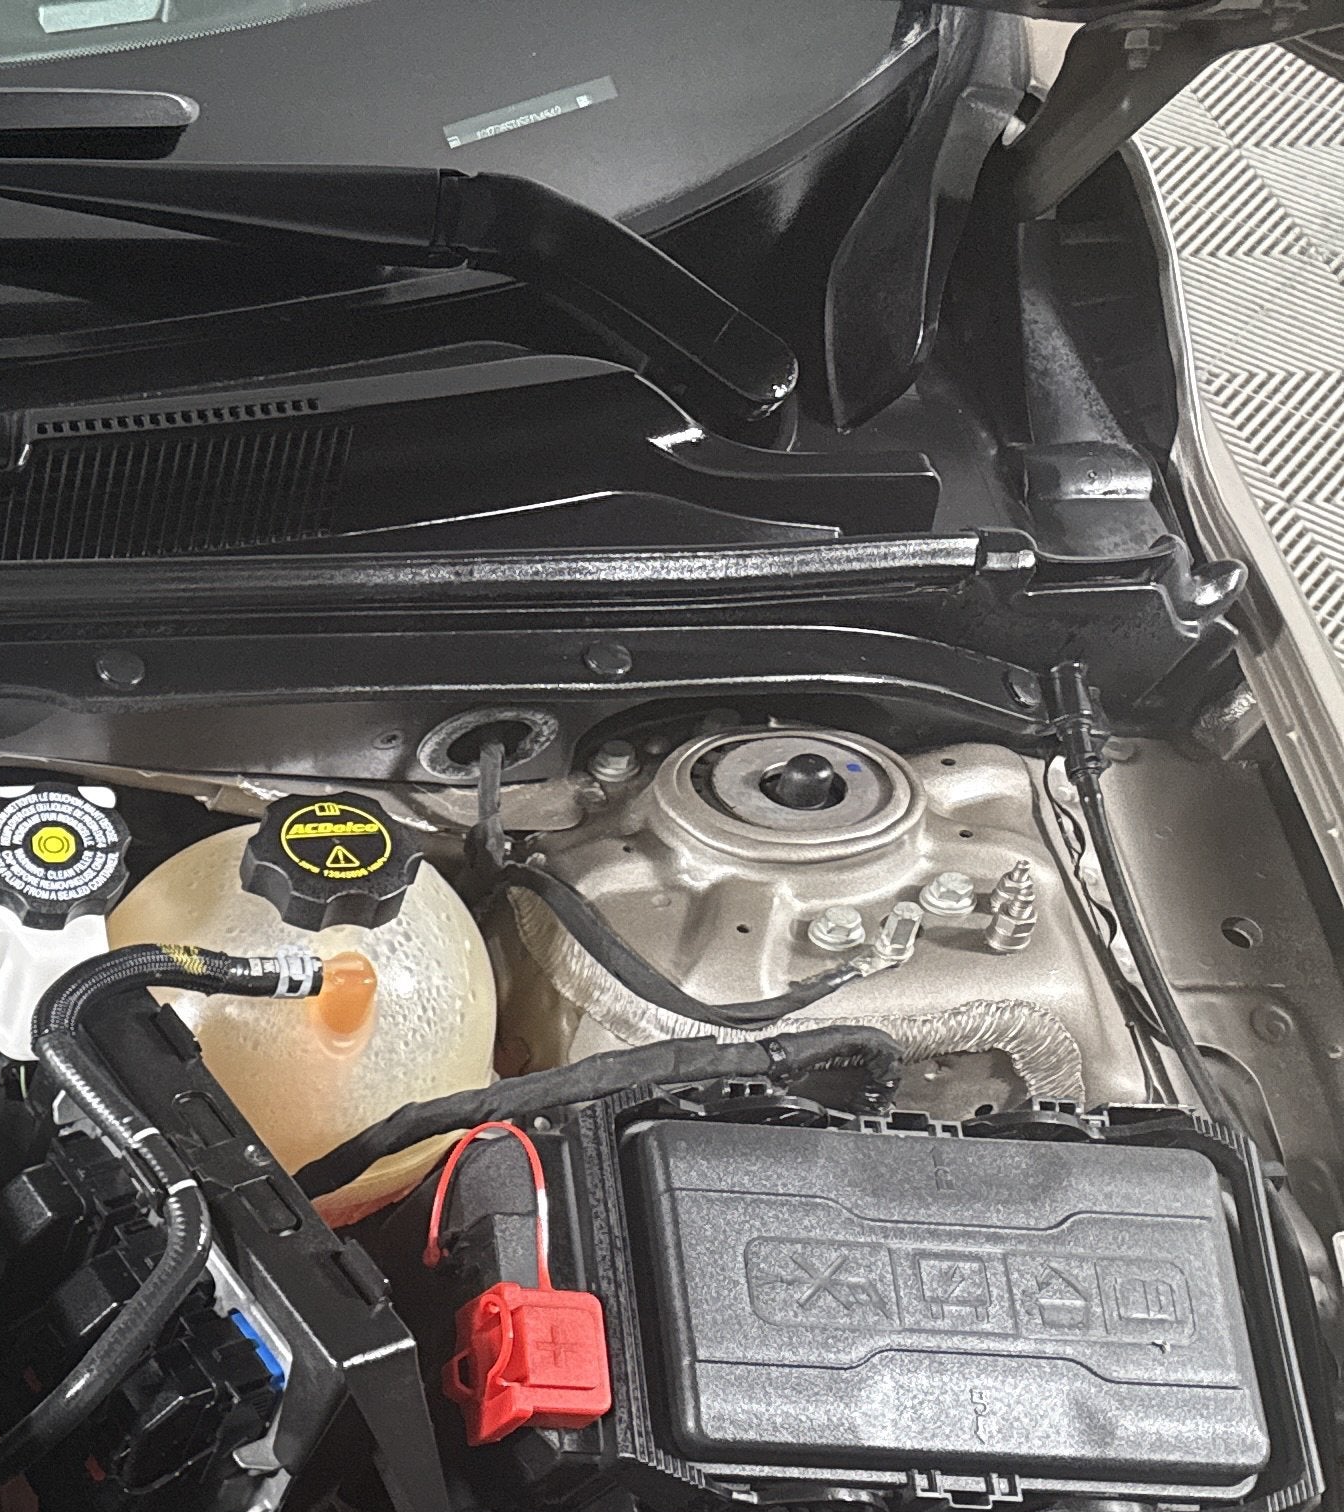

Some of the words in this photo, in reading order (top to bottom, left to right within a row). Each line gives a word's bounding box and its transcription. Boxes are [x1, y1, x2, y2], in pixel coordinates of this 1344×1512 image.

[288, 821, 379, 835] ACDelco
[47, 867, 75, 880] CLEAN
[23, 884, 51, 900] FROM
[57, 885, 91, 900] SEALED
